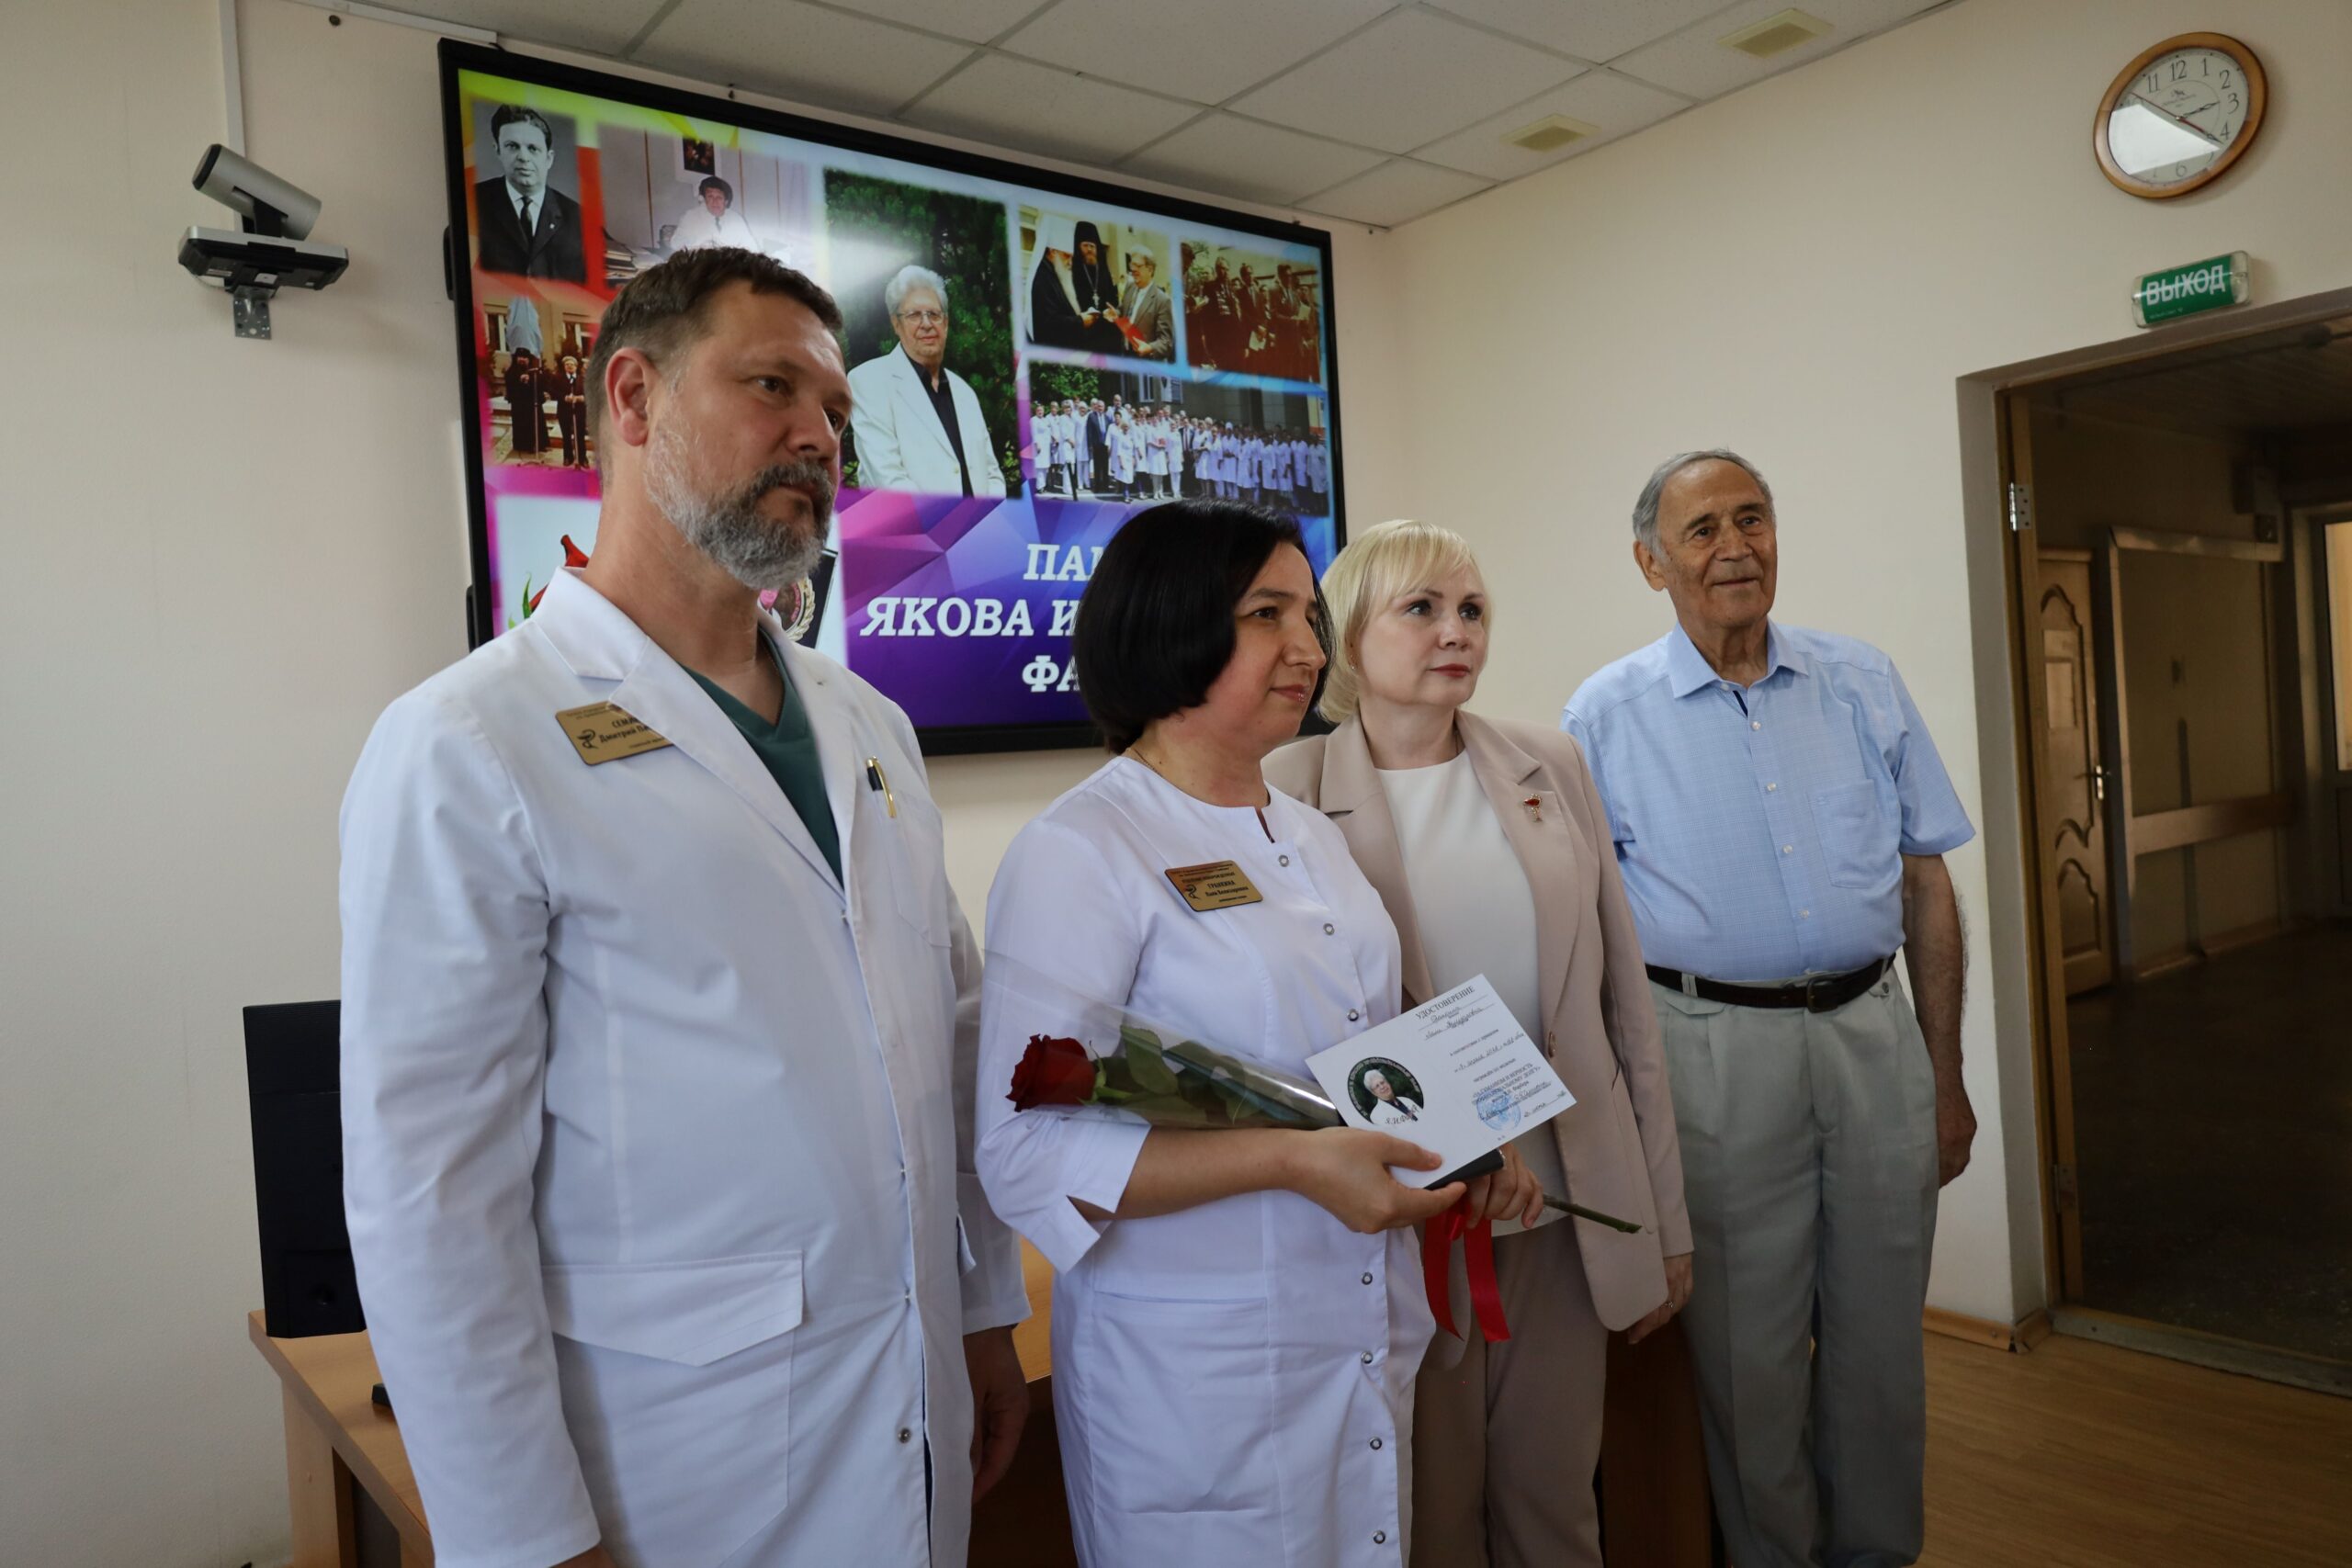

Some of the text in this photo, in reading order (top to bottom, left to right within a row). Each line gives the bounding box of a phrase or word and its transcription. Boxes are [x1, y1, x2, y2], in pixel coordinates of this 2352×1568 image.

[2170, 60, 2188, 82] 12
[2201, 57, 2209, 77] 1
[2146, 73, 2160, 93] 11
[2219, 69, 2231, 90] 2
[2227, 93, 2240, 115] 3
[2220, 120, 2231, 140] 4
[2146, 265, 2226, 306] ВЫХОД
[859, 597, 1035, 637] ЯКОВА
[1415, 985, 1476, 1020] УДОСТОВЕРЕНИЕ
